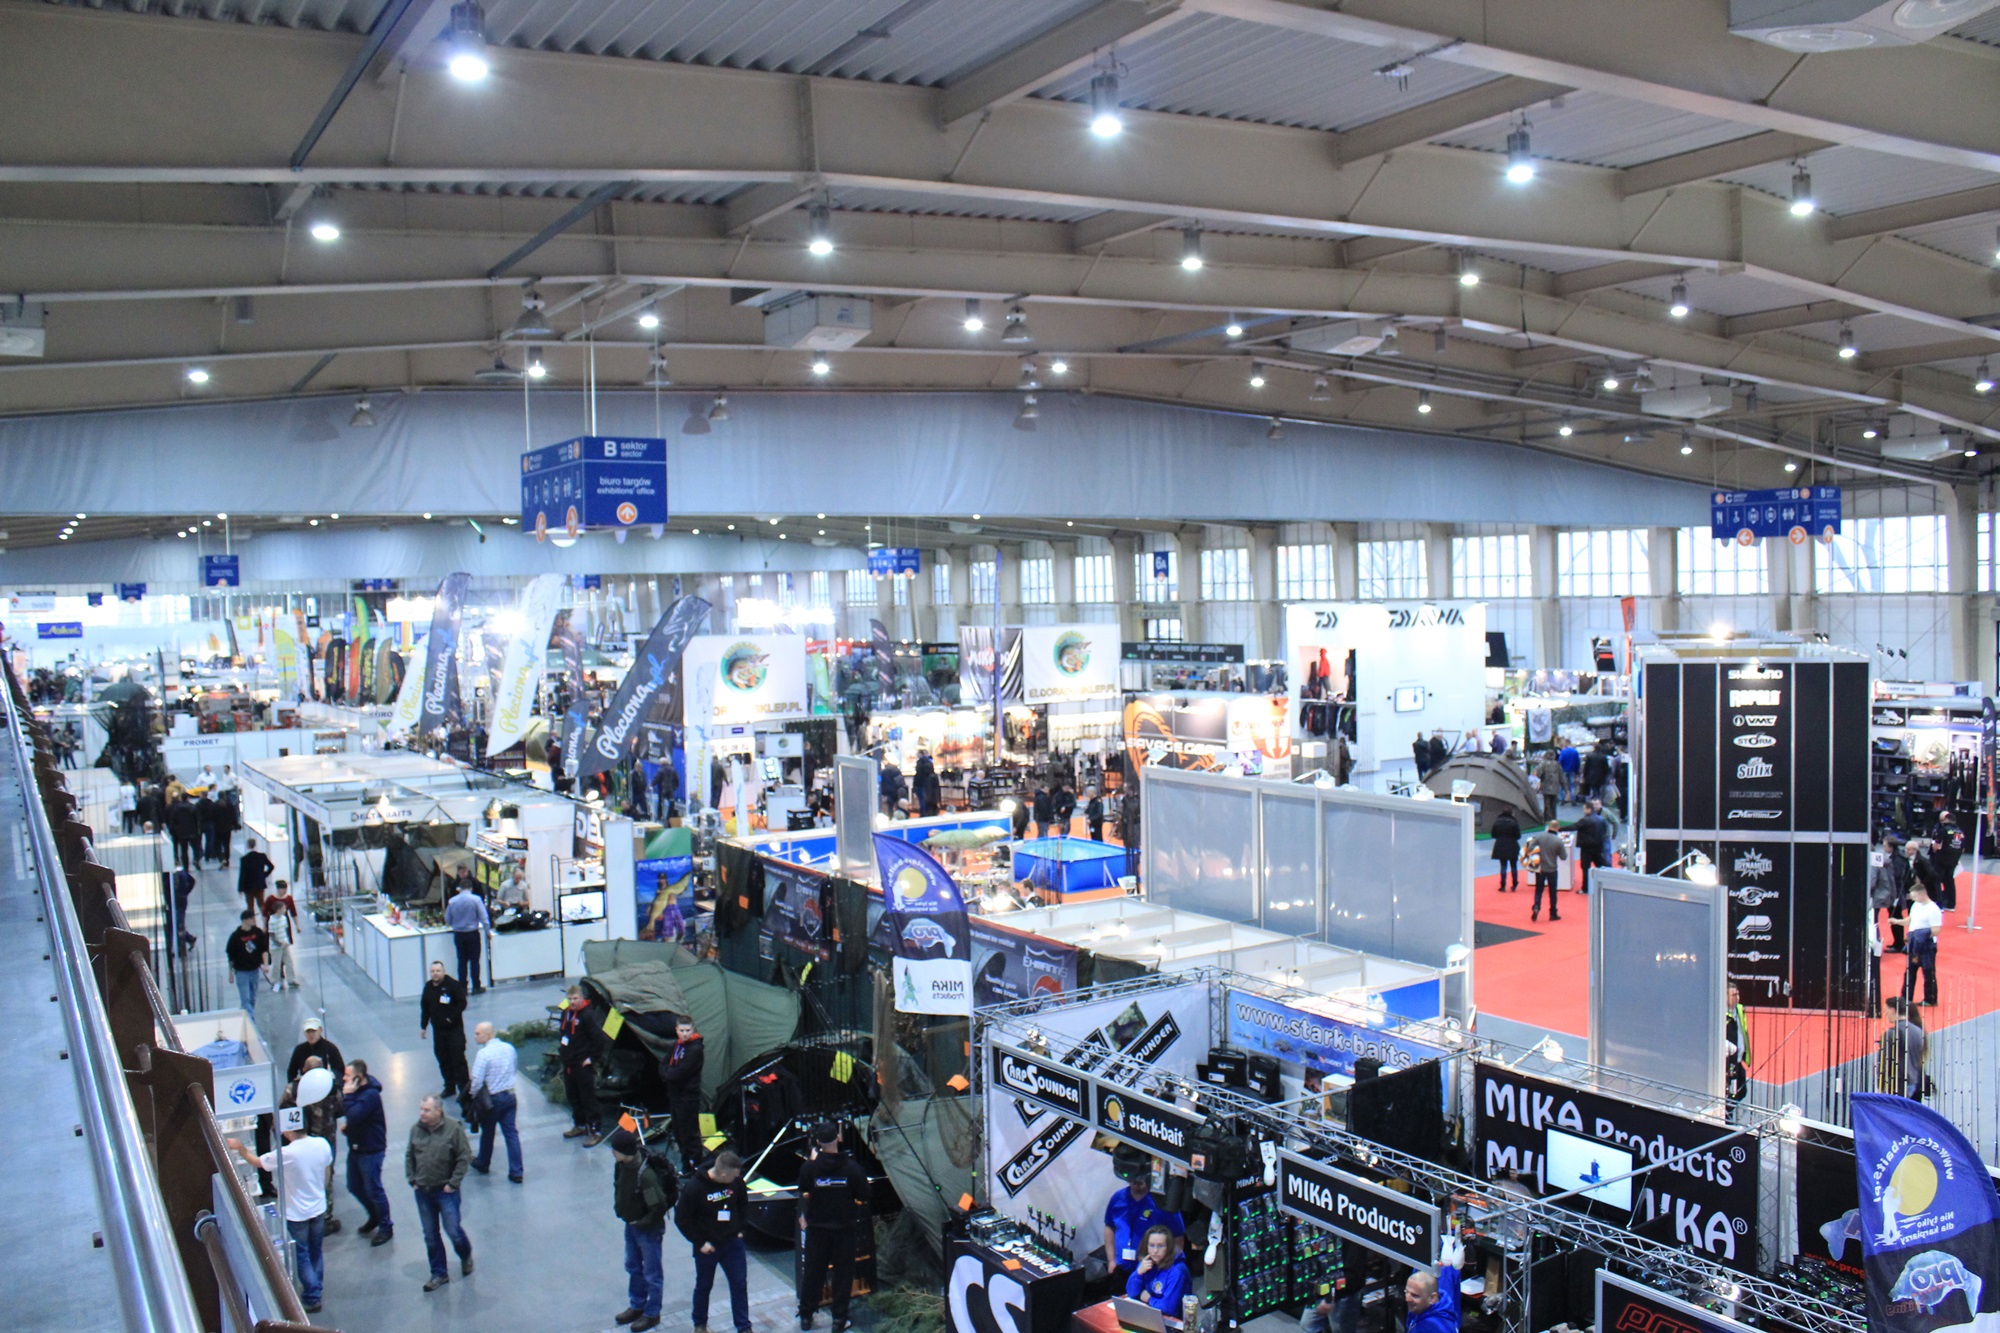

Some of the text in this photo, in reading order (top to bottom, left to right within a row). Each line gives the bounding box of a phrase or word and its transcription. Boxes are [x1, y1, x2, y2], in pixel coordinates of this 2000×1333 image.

[604, 440, 647, 457] B sektor
[620, 450, 643, 458] sector
[599, 476, 651, 488] biuro targów
[636, 487, 655, 496] office
[1747, 716, 1777, 726] VMC
[183, 738, 220, 746] PROMET
[1737, 735, 1772, 746] STORM
[1485, 1078, 1584, 1132] MIKA
[288, 1110, 300, 1123] 42
[1129, 1113, 1185, 1148] stark-bait
[1288, 1173, 1334, 1212] MIKA
